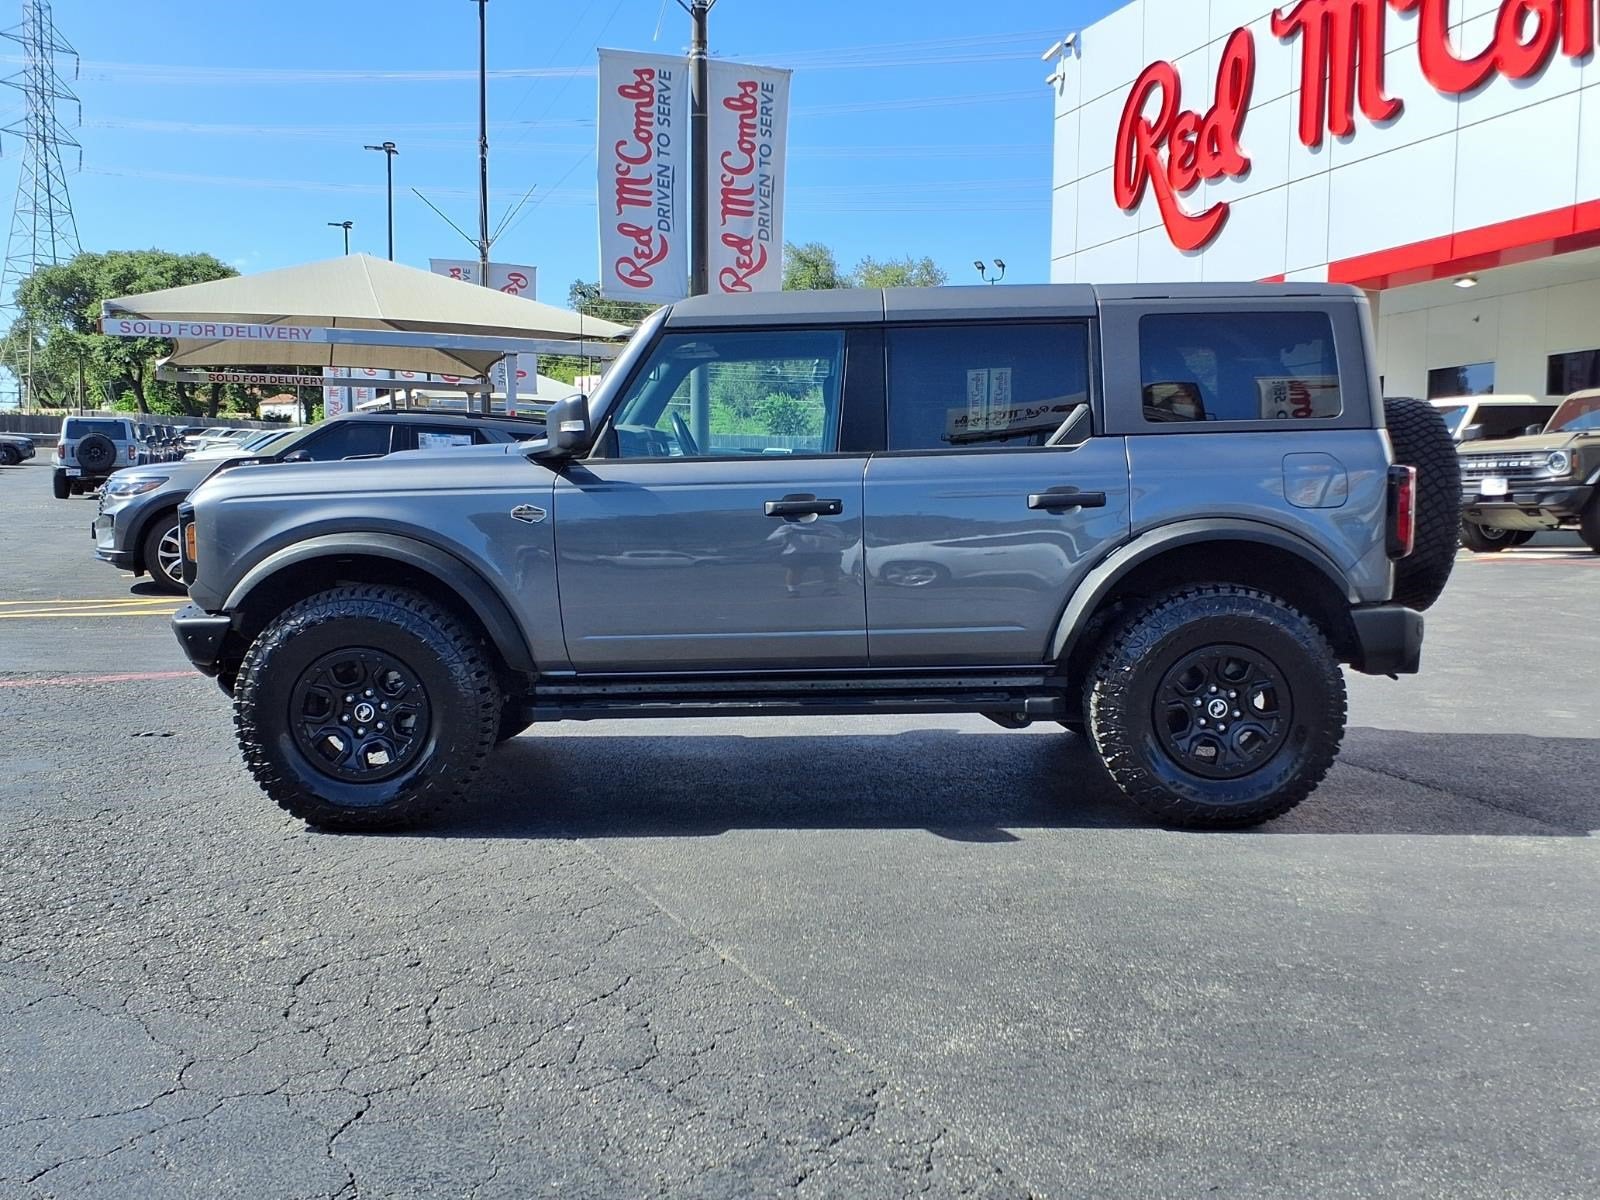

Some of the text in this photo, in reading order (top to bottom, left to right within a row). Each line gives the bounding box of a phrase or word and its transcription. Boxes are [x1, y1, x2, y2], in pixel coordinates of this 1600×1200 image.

[615, 68, 669, 288] Red McCombs
[657, 69, 672, 233] DRIVEN TO SERVE
[719, 80, 767, 293] Red McCombs
[758, 82, 774, 242] DRIVEN TO SERVE
[1114, 27, 1256, 251] Red
[119, 321, 313, 341] SOLD FOR DELIVERY
[208, 373, 325, 386] SOLD FOR DELIVERY
[497, 361, 506, 387] ERVE
